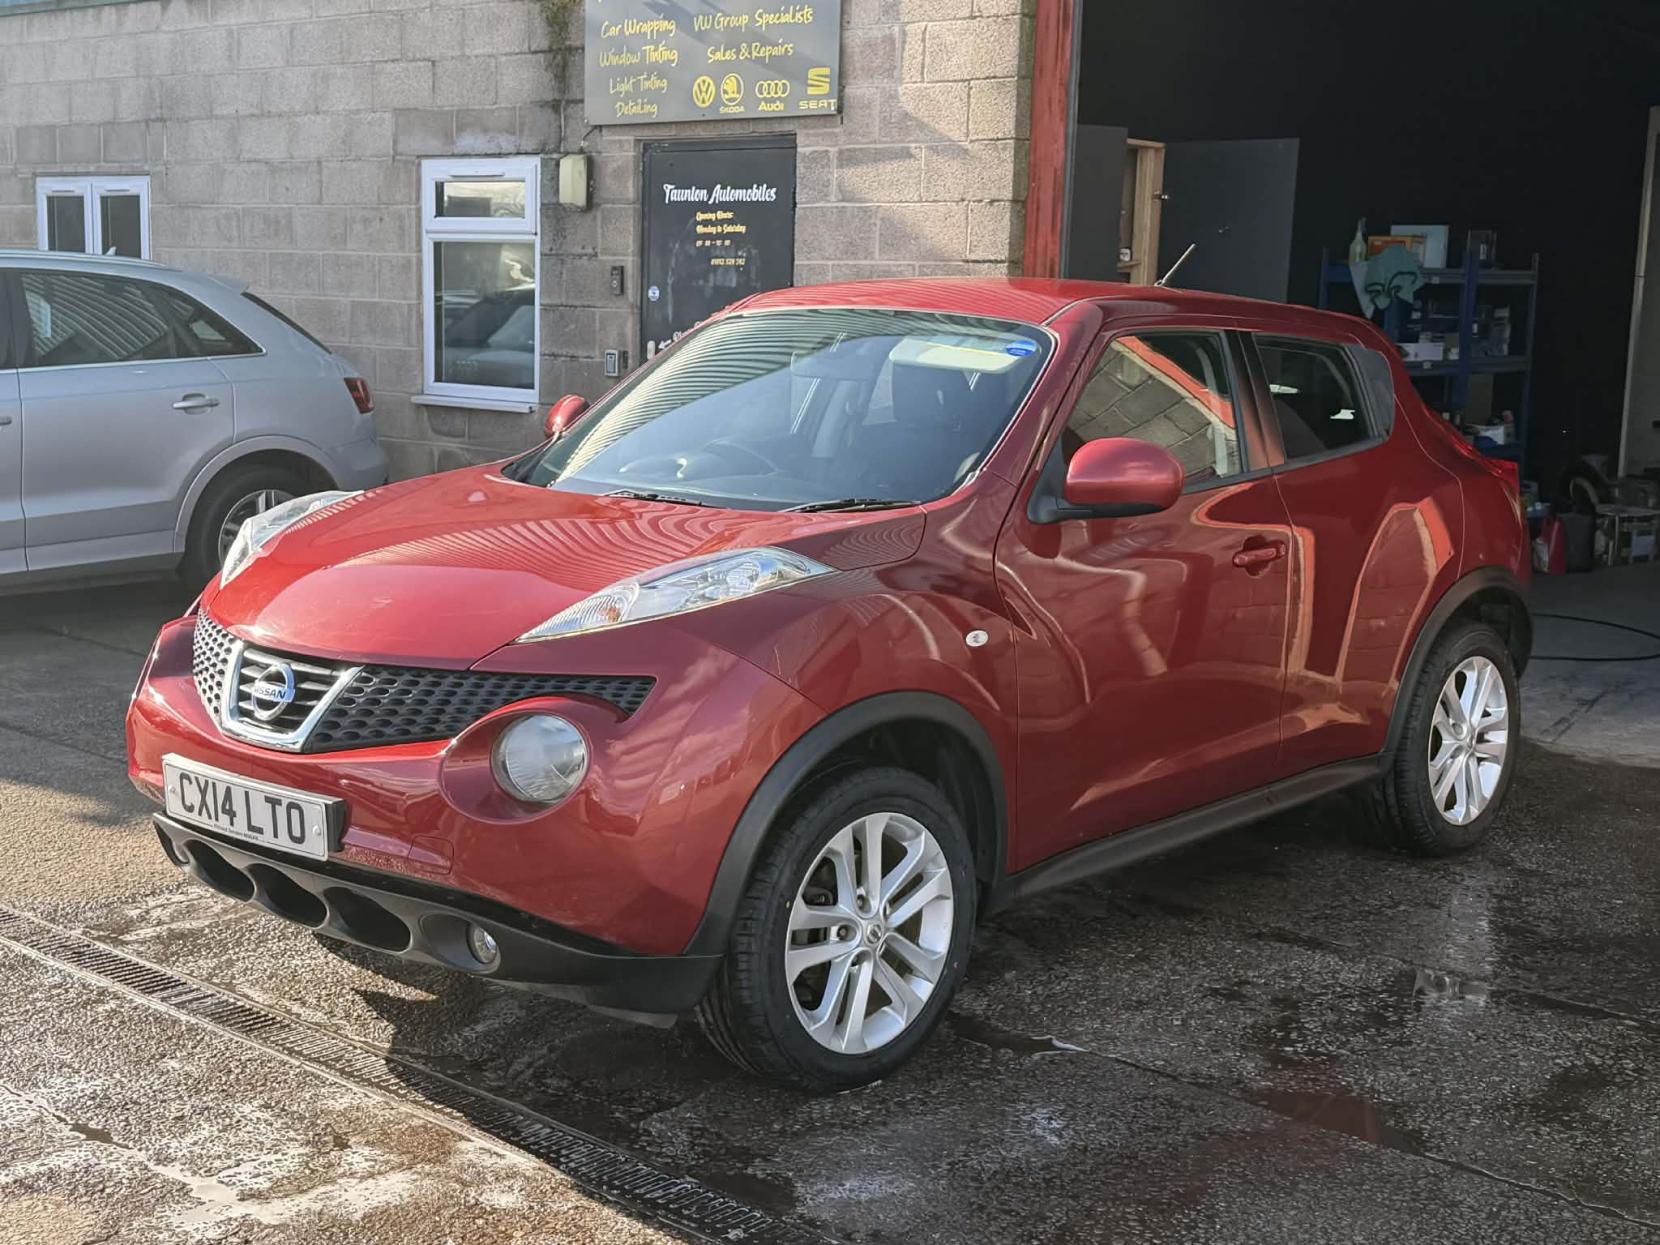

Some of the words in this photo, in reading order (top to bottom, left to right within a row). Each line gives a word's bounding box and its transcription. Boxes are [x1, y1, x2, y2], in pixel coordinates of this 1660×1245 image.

[601, 20, 622, 39] Car
[624, 13, 676, 39] Wrapping
[693, 14, 712, 32] VW
[714, 13, 749, 32] Group
[754, 5, 813, 31] Specialists
[600, 45, 641, 67] Window
[641, 40, 678, 67] Tinting
[707, 45, 736, 63] Sales
[739, 43, 750, 60] &
[751, 38, 794, 63] Repairs
[609, 76, 636, 97] Light
[637, 72, 668, 94] Tinting
[615, 98, 658, 118] Detailing
[758, 101, 785, 112] Audi
[800, 98, 838, 111] SEAT
[663, 183, 709, 204] Taunton
[708, 183, 777, 204] Automobiles
[179, 772, 236, 827] CX14
[245, 790, 306, 845] LTO
